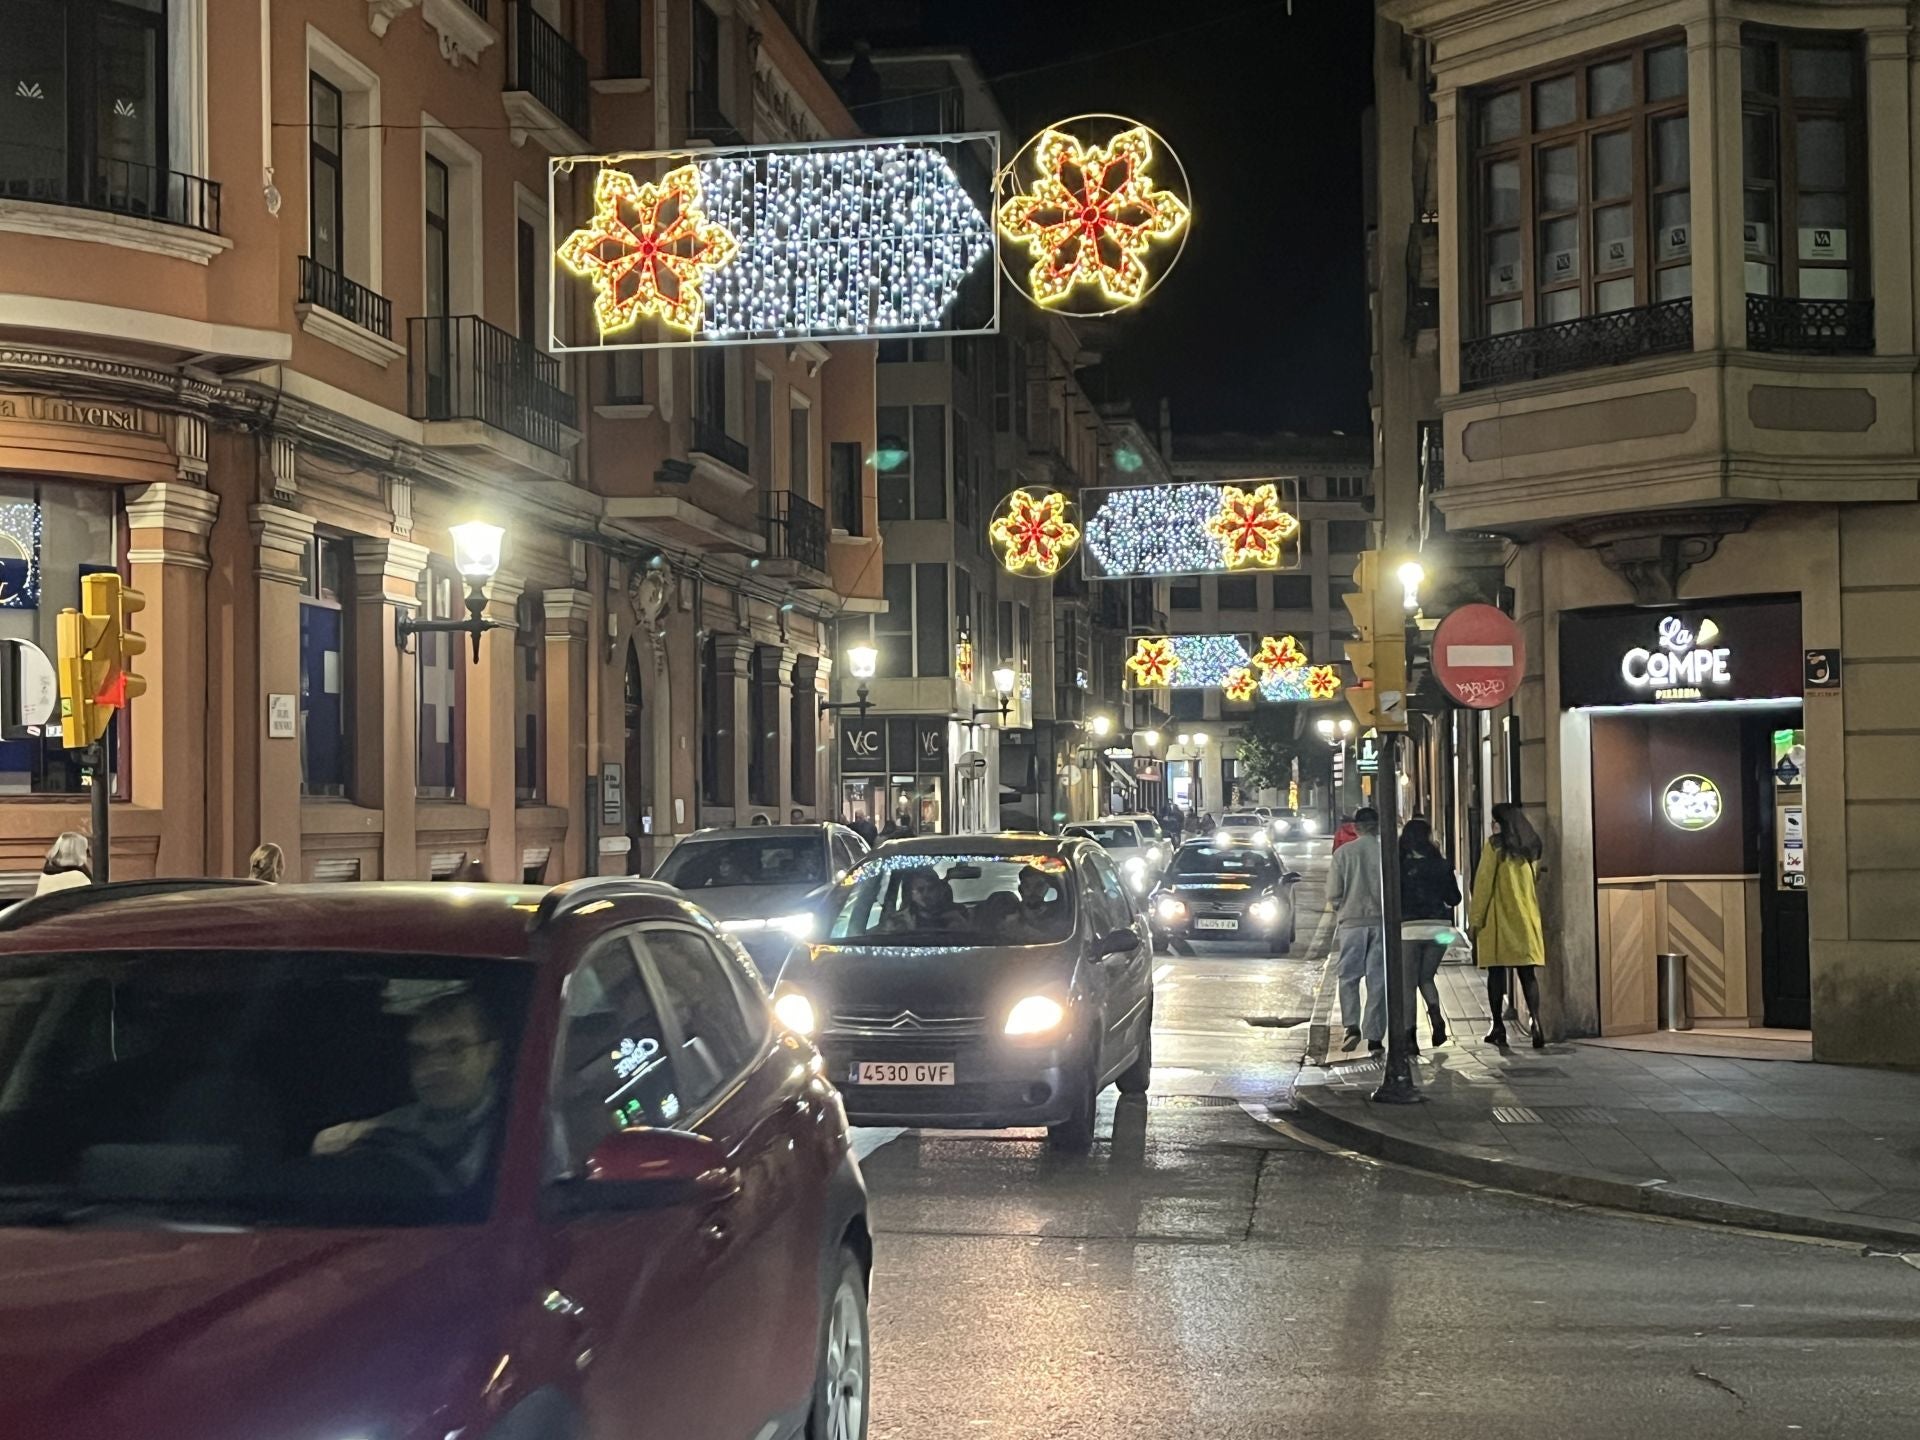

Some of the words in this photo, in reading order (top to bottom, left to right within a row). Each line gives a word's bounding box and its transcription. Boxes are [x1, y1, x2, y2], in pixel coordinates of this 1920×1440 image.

[1814, 231, 1830, 246] VA
[24, 395, 143, 431] Universal
[1658, 615, 1693, 650] La
[863, 1065, 908, 1082] 4530
[915, 1065, 949, 1082] GVF
